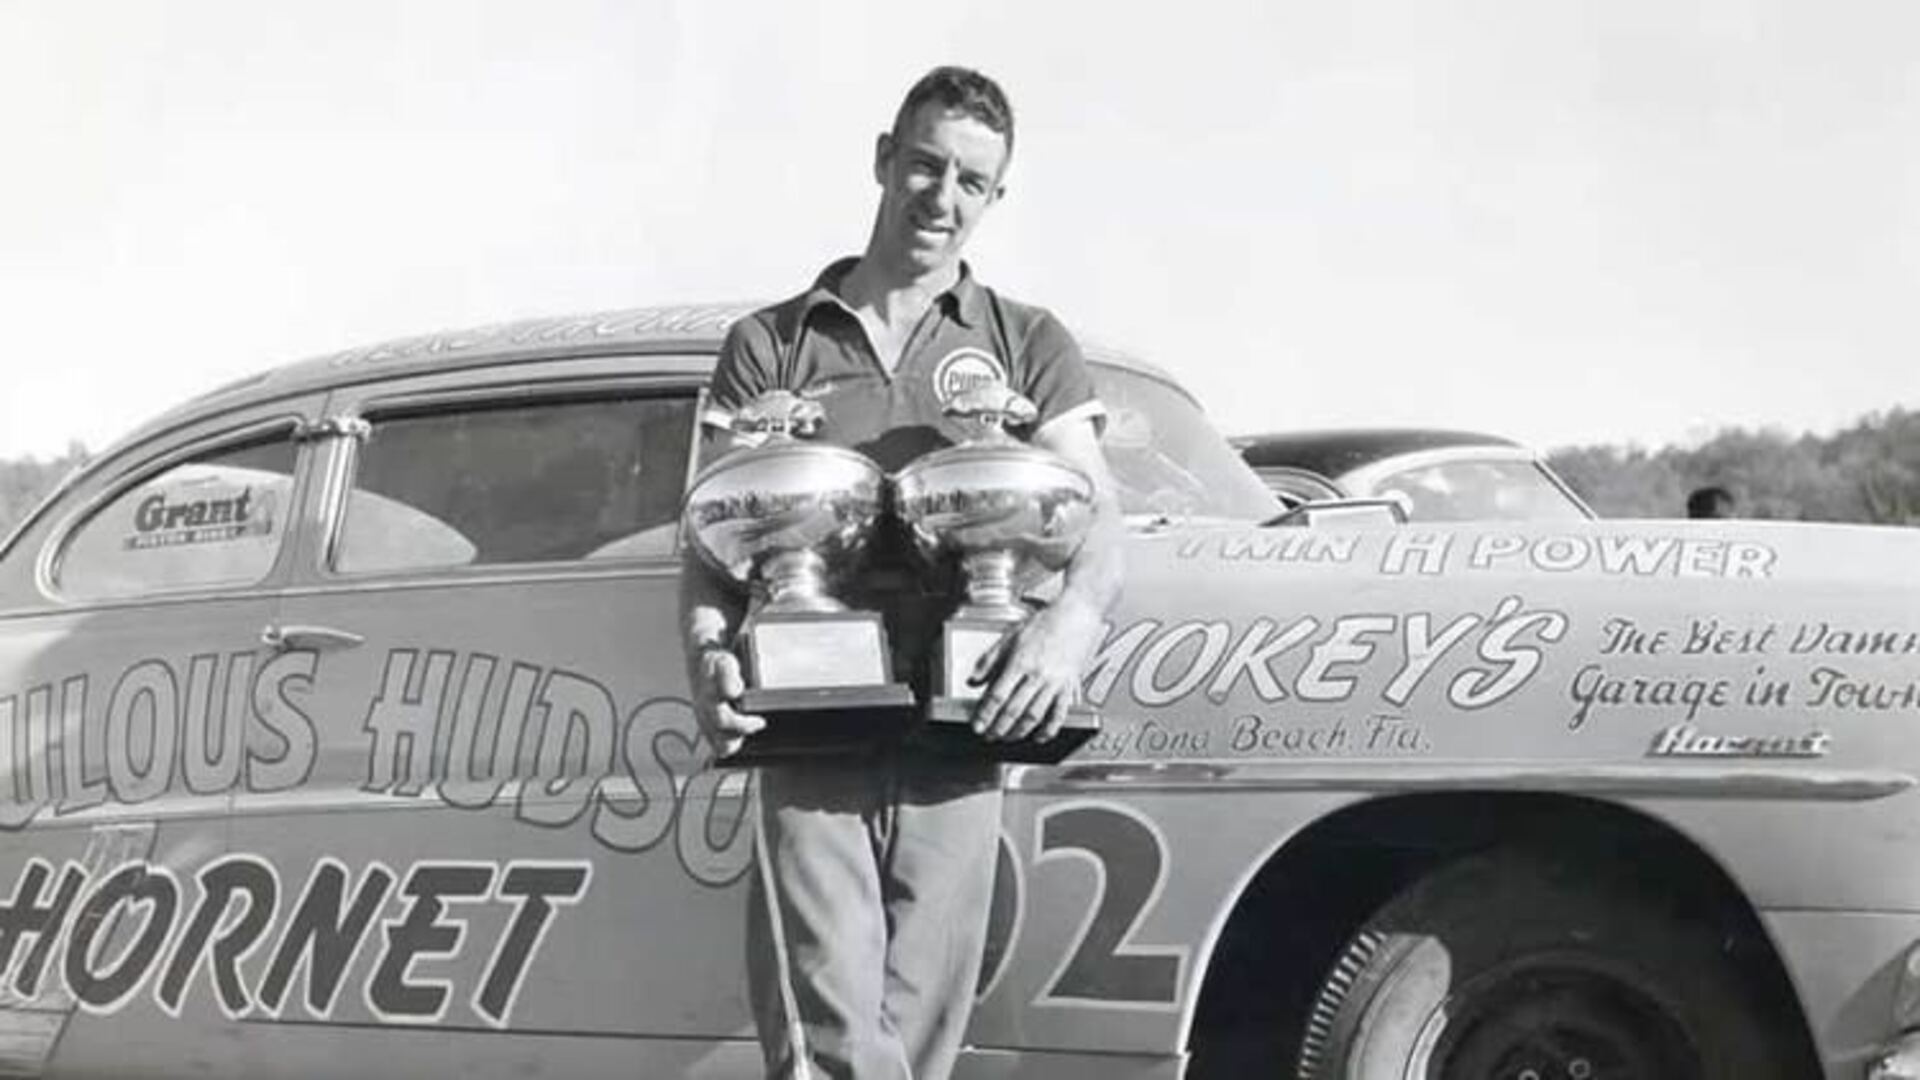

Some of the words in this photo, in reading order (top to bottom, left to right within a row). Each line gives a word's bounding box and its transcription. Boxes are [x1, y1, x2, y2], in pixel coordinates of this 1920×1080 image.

[135, 486, 250, 532] Grant
[1176, 533, 1362, 562] TWIN
[1379, 530, 1454, 575] H
[1469, 533, 1778, 577] POWER
[1601, 617, 1670, 655] The
[1682, 619, 1779, 655] Best
[1568, 663, 1732, 731] Garage
[1746, 665, 1791, 707] in
[1805, 666, 1920, 710] Town
[974, 800, 1190, 1012] 2
[0, 853, 592, 1027] HORNET
